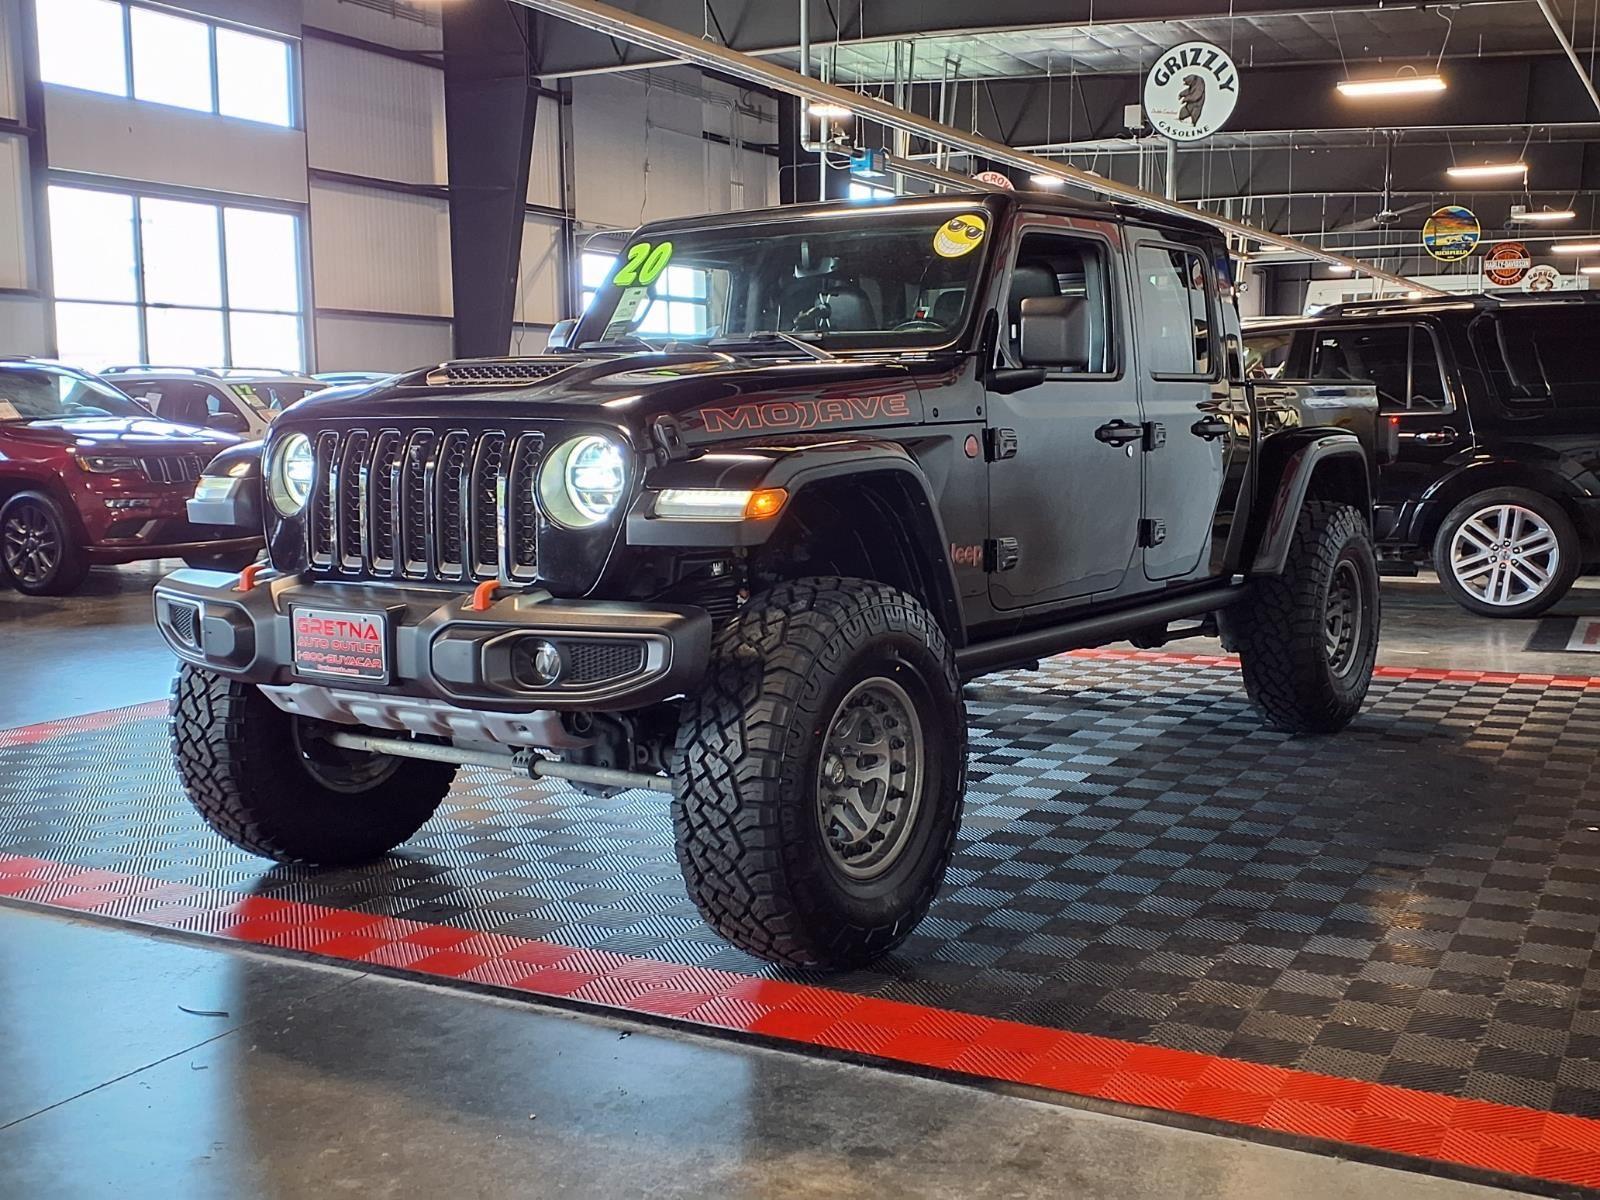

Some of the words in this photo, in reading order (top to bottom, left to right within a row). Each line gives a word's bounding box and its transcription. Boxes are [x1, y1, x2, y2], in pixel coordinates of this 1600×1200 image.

[1154, 47, 1235, 92] GRIZZLY
[1158, 120, 1210, 137] GASOLINE
[613, 242, 673, 286] 20
[700, 394, 910, 432] MOJAVE
[950, 543, 982, 567] Jeep
[297, 617, 379, 640] GRETNA
[297, 636, 329, 649] AUTO
[331, 640, 381, 654] OUTLET
